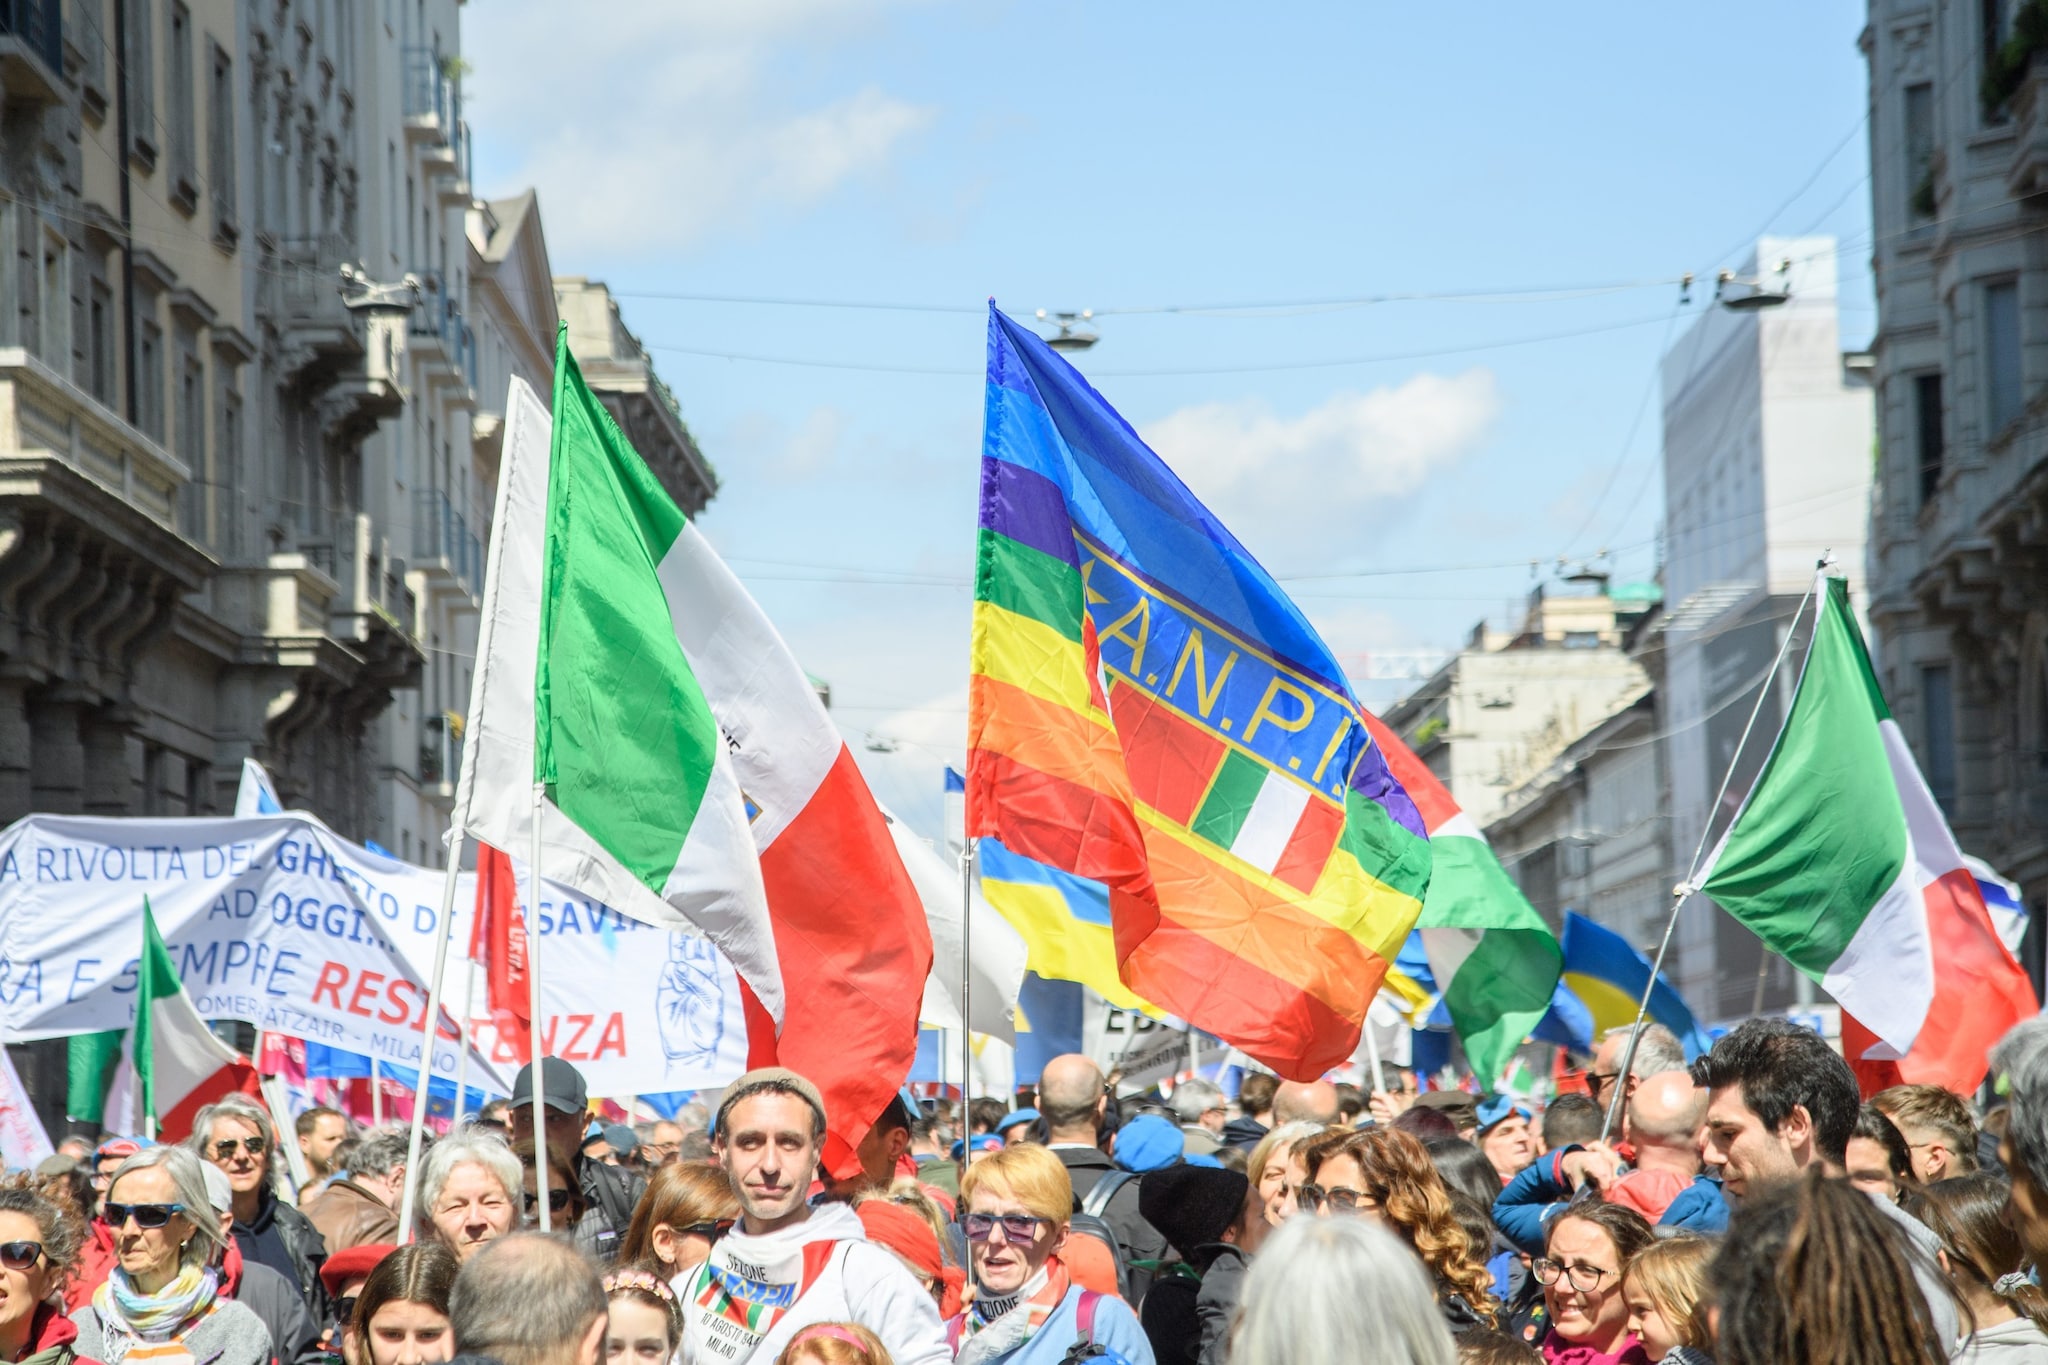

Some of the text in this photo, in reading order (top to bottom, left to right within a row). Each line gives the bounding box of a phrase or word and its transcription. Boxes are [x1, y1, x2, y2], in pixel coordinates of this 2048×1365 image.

[37, 845, 188, 882] RIVOLTA
[203, 842, 262, 879] DEL
[208, 888, 396, 953] AD OGGI...
[66, 958, 102, 1004] E
[700, 1312, 713, 1326] 10
[709, 1317, 743, 1342] AGOSTO
[705, 1335, 737, 1360] MILANO
